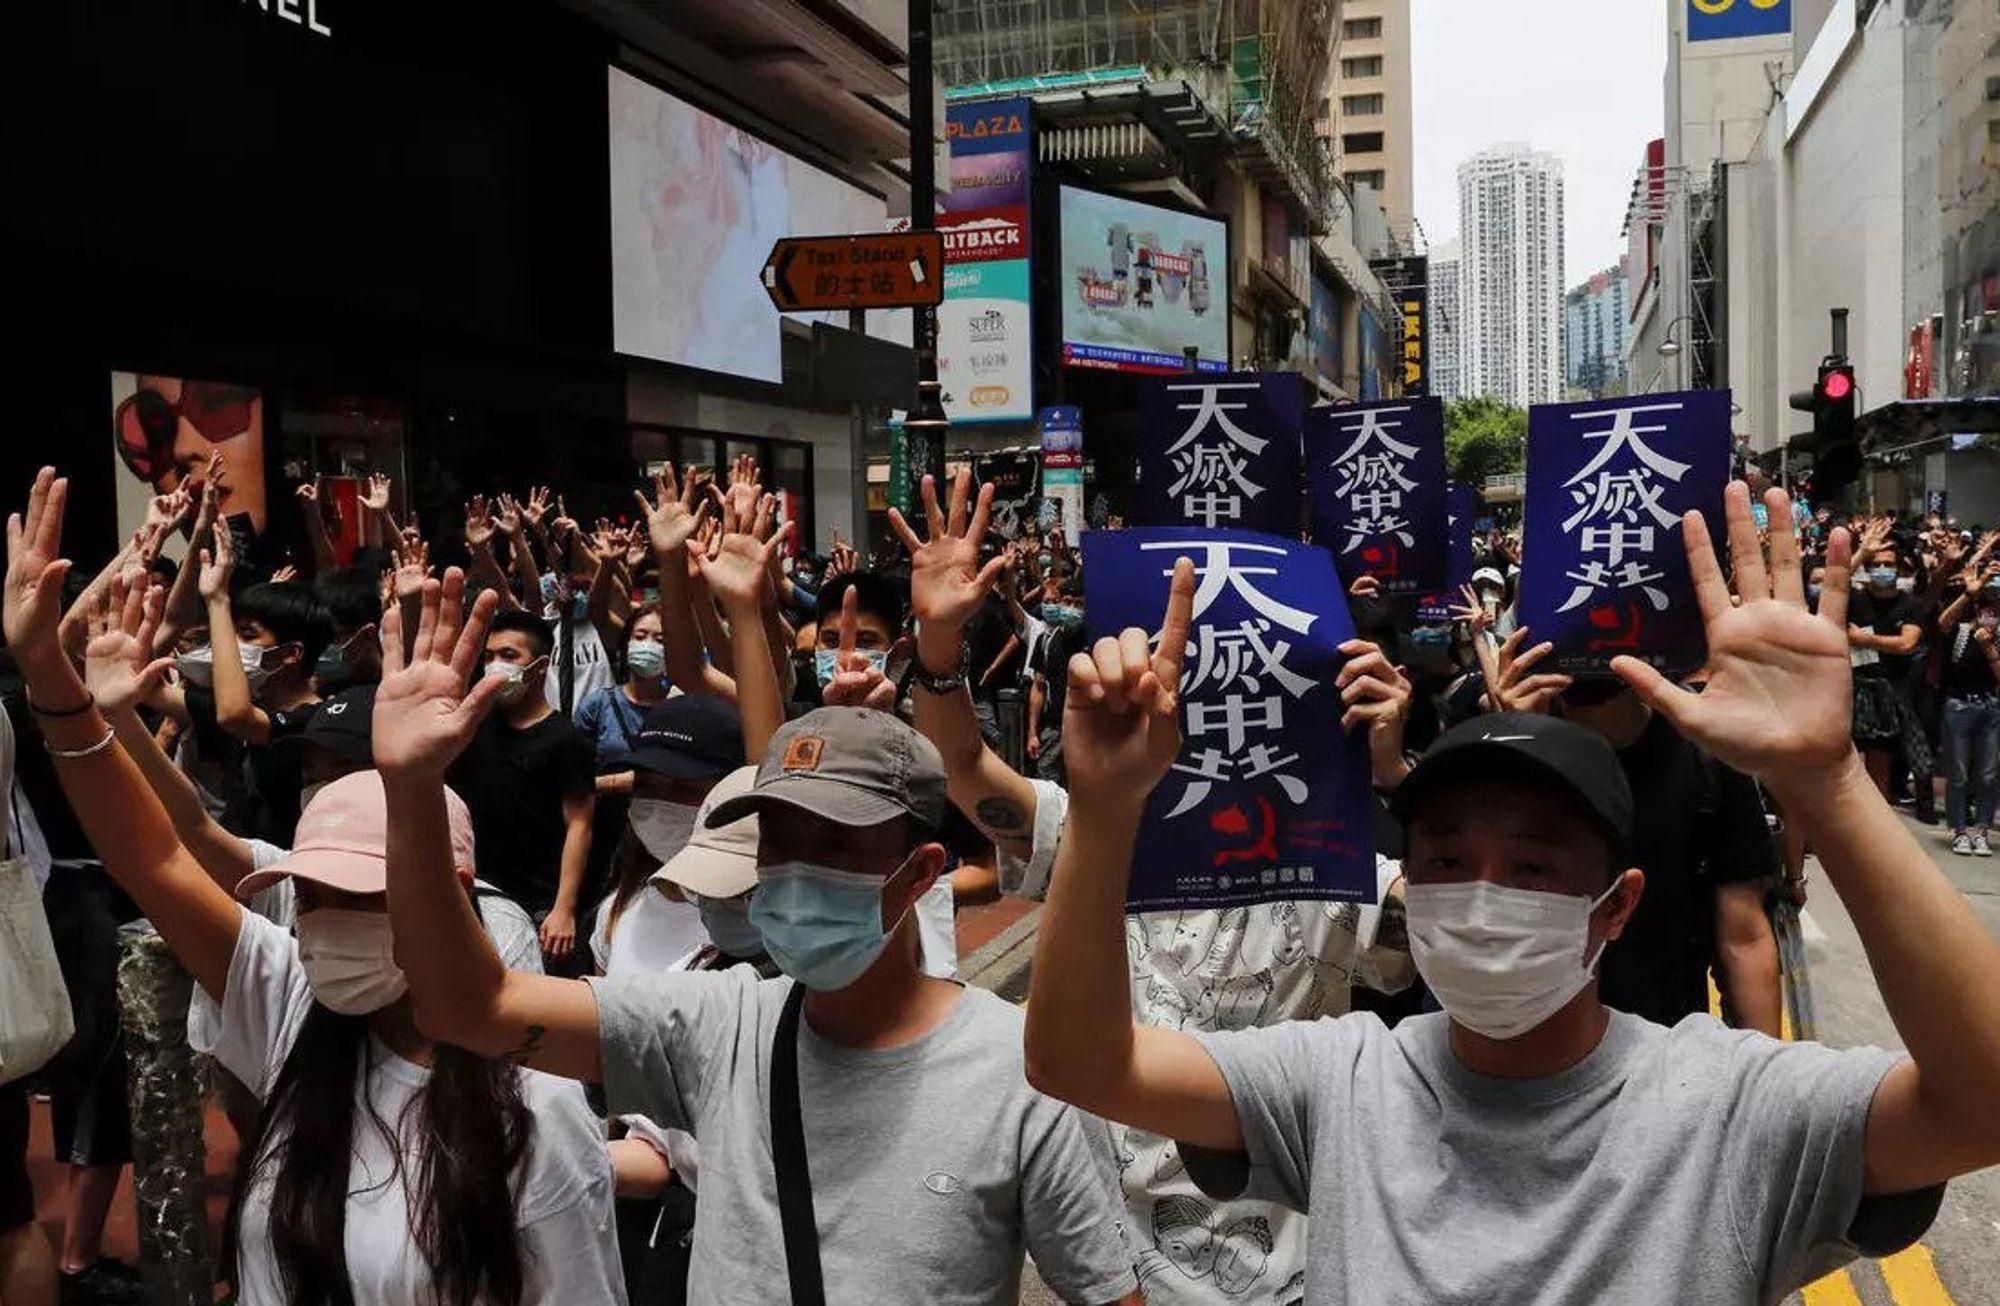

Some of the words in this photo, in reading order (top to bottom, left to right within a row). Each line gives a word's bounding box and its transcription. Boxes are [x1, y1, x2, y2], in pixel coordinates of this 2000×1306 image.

[945, 115, 1023, 140] PLAZA
[804, 249, 841, 264] Taxi
[850, 247, 904, 264] Stand
[943, 229, 1019, 250] UTBACK
[814, 270, 895, 297] 的士站
[1404, 301, 1420, 386] IKEA
[1164, 383, 1270, 528] 天滅中
[1330, 406, 1421, 555] 天滅中共
[1555, 403, 1693, 613] 天滅中共
[1140, 541, 1320, 820] 天滅中共
